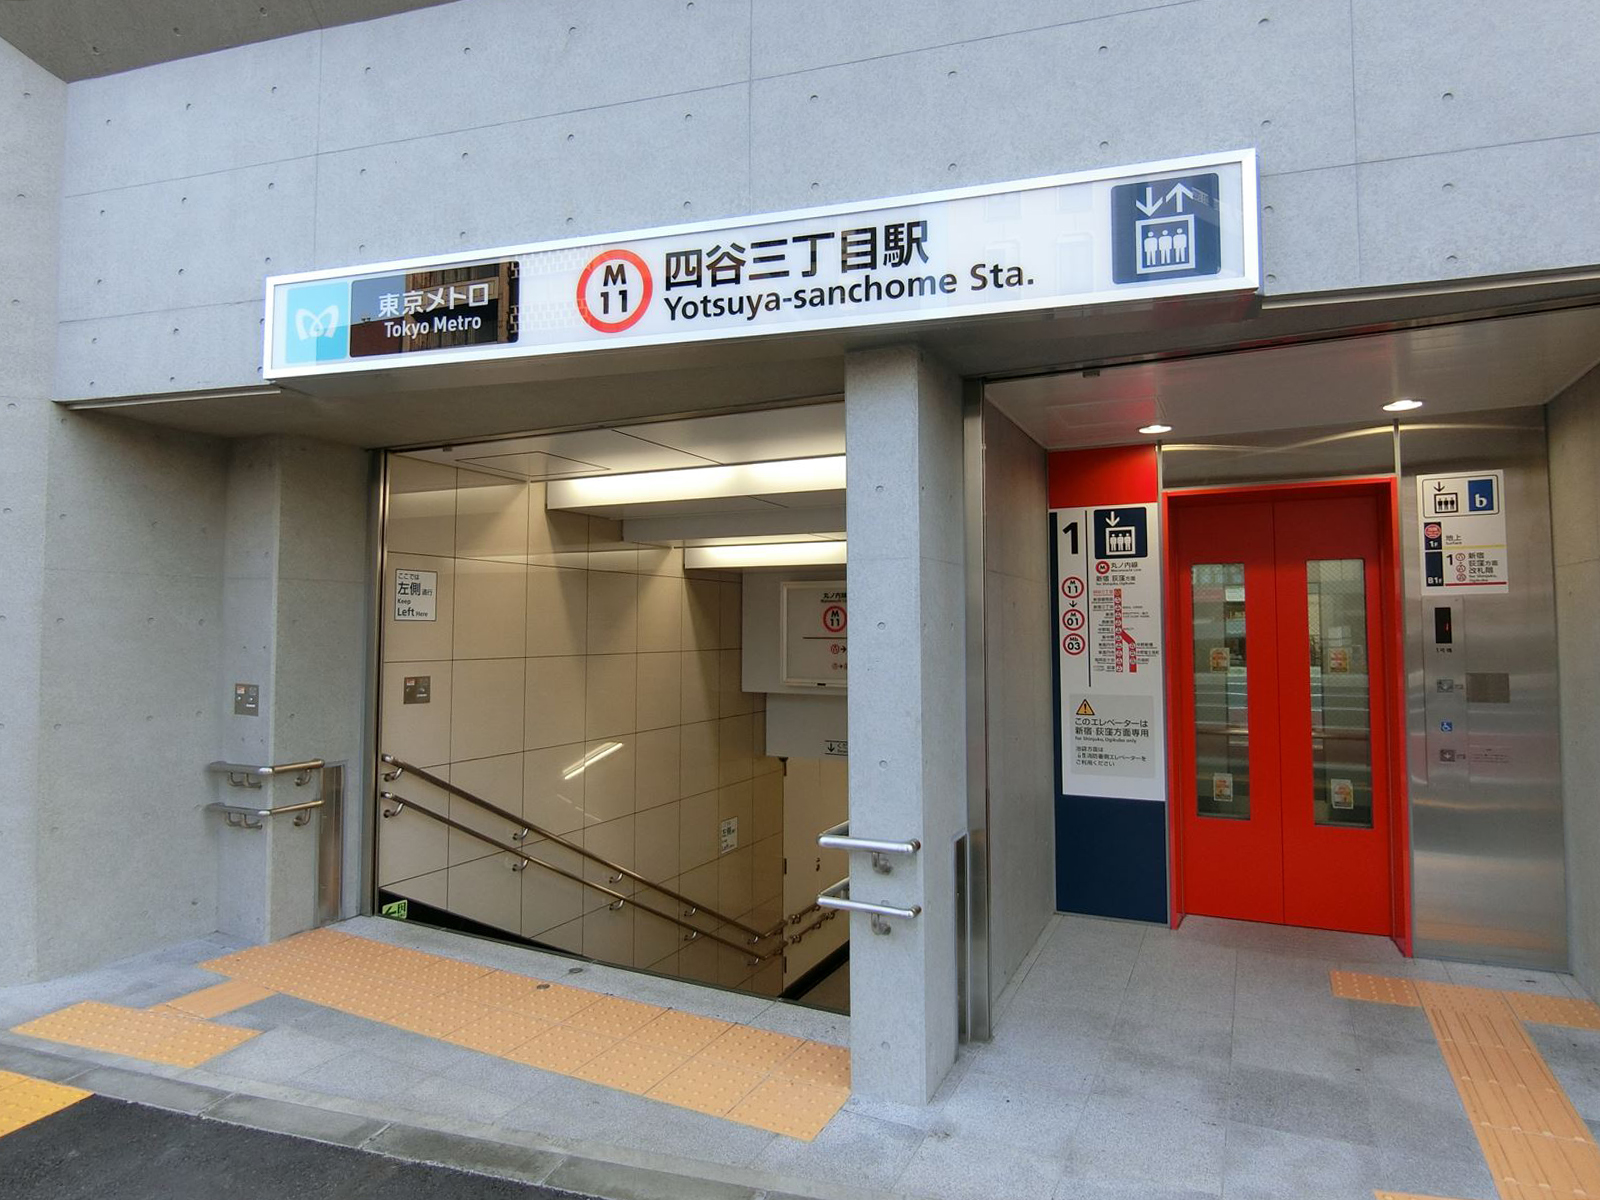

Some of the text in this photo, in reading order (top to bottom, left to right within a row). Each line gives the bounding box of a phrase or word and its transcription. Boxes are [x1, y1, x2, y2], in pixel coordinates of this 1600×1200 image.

[665, 219, 930, 292] 四谷三丁目駅
[603, 263, 627, 285] M
[663, 262, 1035, 322] Yotsuya-sanchome Sta.
[377, 282, 490, 318] 東京メトロ
[601, 290, 629, 314] 11
[384, 314, 482, 341] Tokyo Metro
[1474, 493, 1488, 508] b
[1062, 521, 1079, 555] 1
[1111, 561, 1138, 569] 丸ノ内線
[1446, 554, 1453, 565] 1
[397, 572, 420, 580] ここでは
[1067, 585, 1078, 594] 11
[397, 607, 415, 617] Left
[830, 618, 840, 627] 11
[1066, 617, 1079, 626] 01
[1067, 641, 1081, 651] 03
[1075, 718, 1149, 727] このエレベーターは
